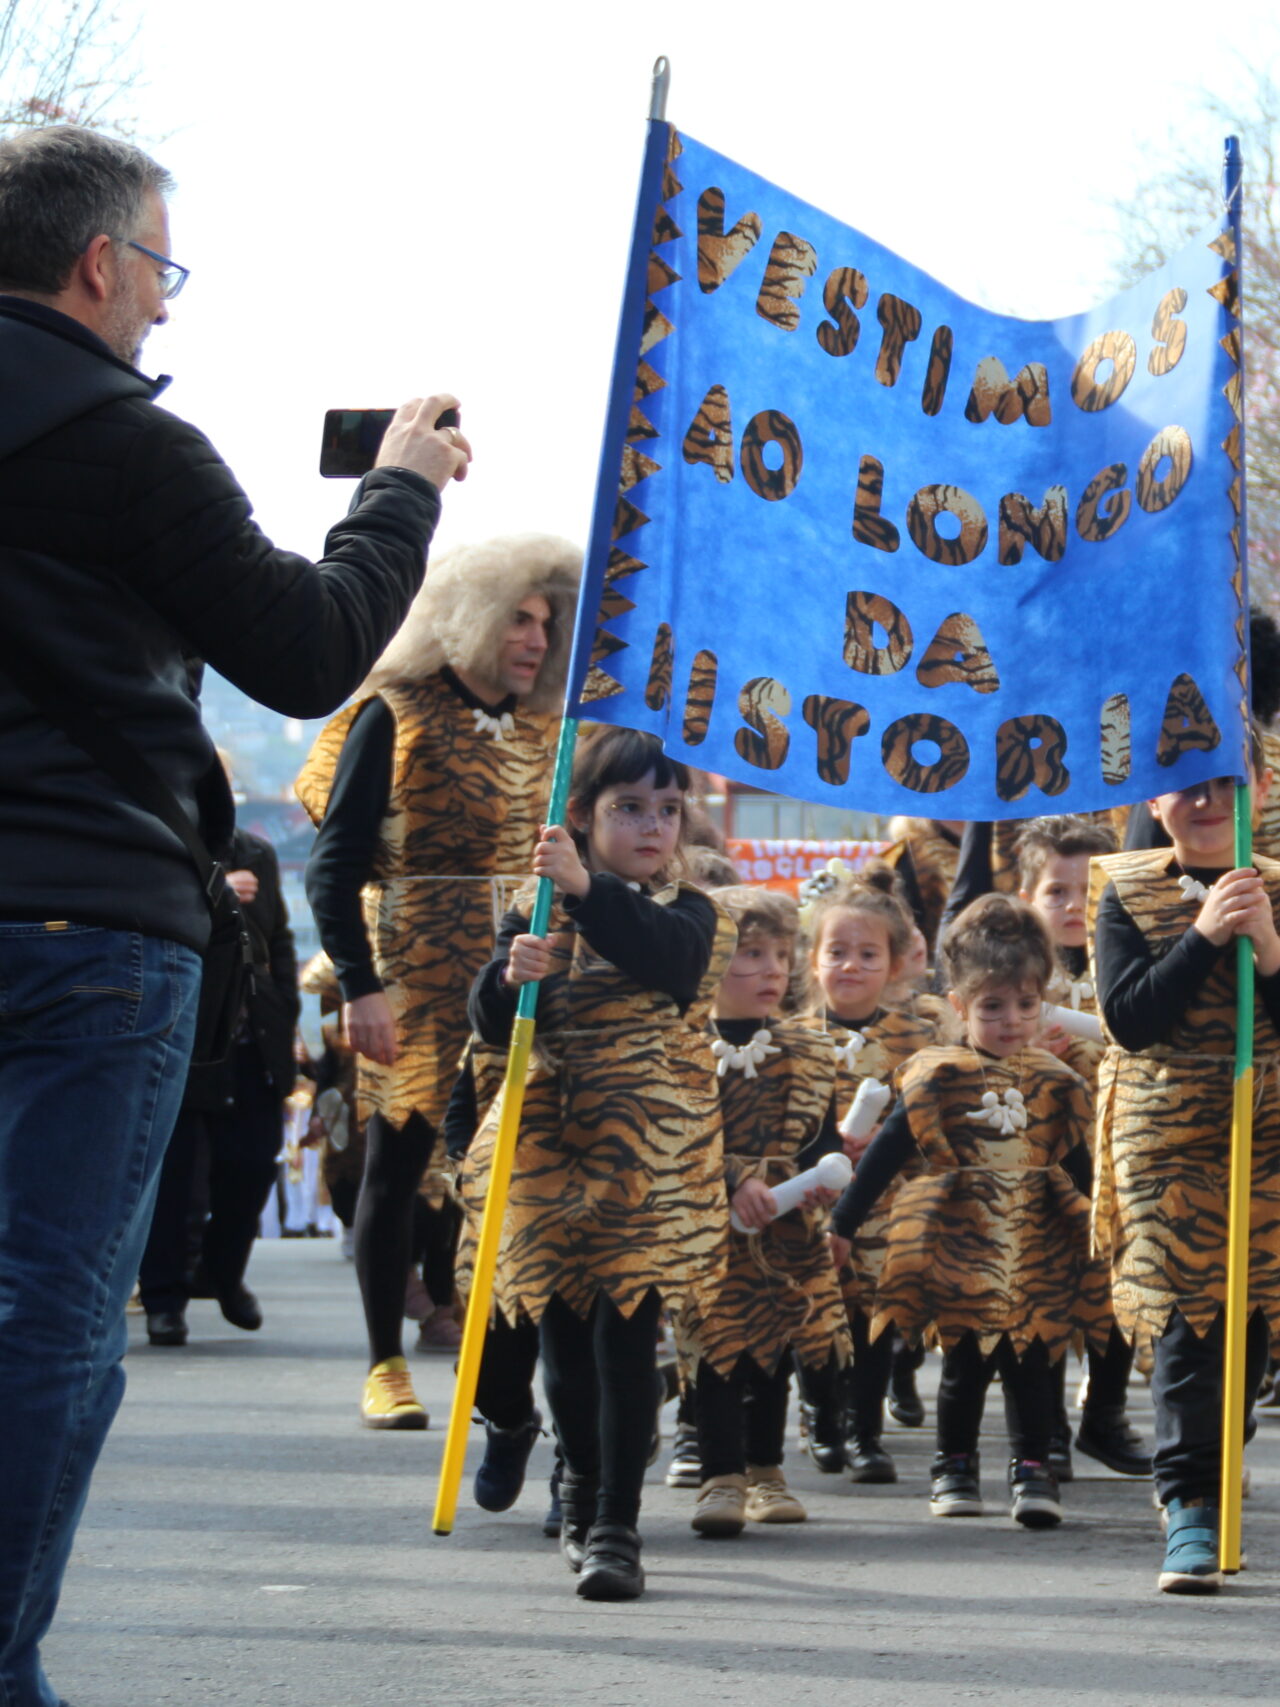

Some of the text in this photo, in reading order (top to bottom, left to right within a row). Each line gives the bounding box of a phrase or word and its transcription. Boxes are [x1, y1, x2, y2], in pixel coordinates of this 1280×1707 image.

[697, 187, 1189, 427] VESTIMOS
[683, 384, 1193, 565] AO LONGO
[843, 591, 999, 694] DA
